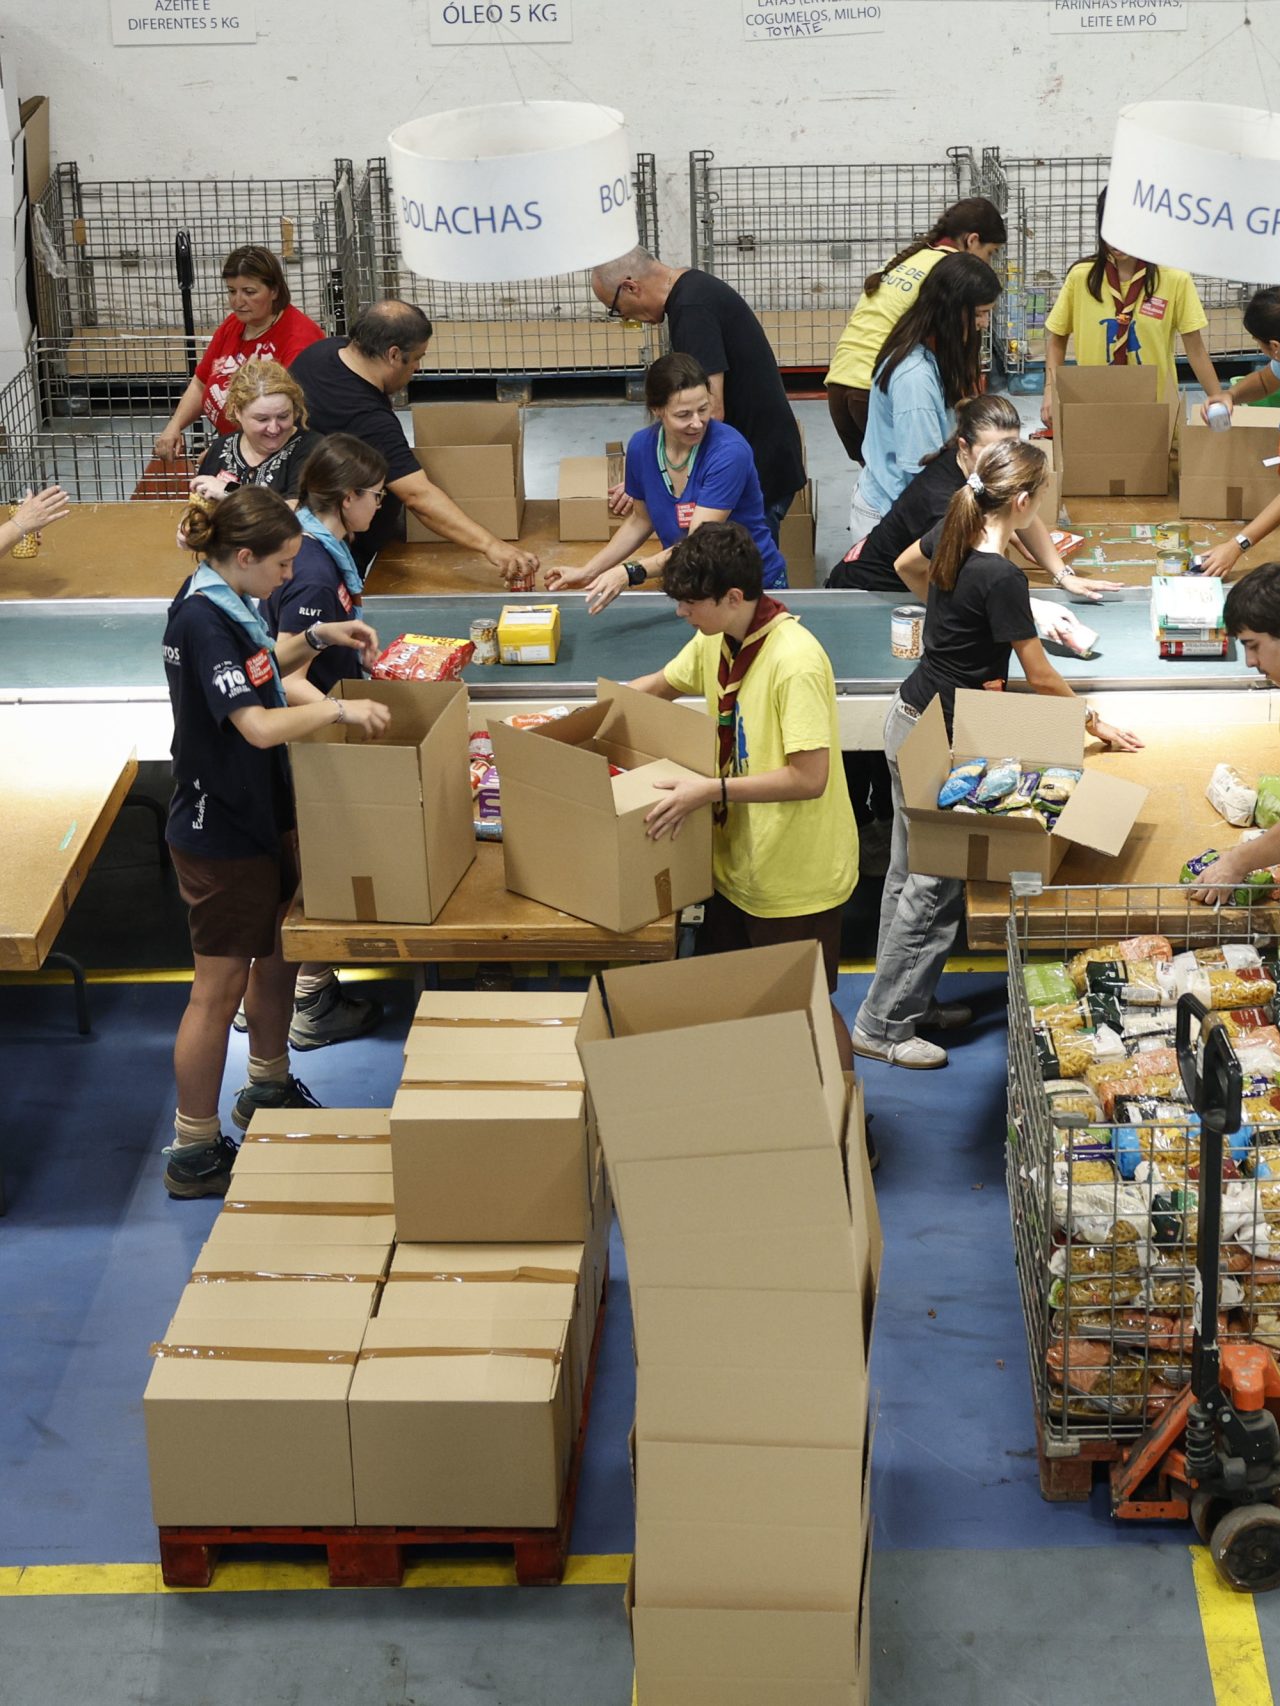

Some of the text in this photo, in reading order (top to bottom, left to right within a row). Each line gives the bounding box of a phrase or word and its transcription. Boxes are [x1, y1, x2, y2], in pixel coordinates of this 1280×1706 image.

[155, 0, 199, 11] AZEITE
[442, 1, 557, 24] ÓLEO 5 KG
[128, 16, 240, 30] DIFERENTES 5 KG
[745, 6, 881, 26] COGUMELOS, MILHO)
[1080, 12, 1157, 28] LEITE EM PÓ
[766, 22, 824, 37] TOMATE
[1132, 179, 1234, 231] MASSA
[402, 196, 543, 235] BOLACHAS
[214, 669, 246, 695] 110
